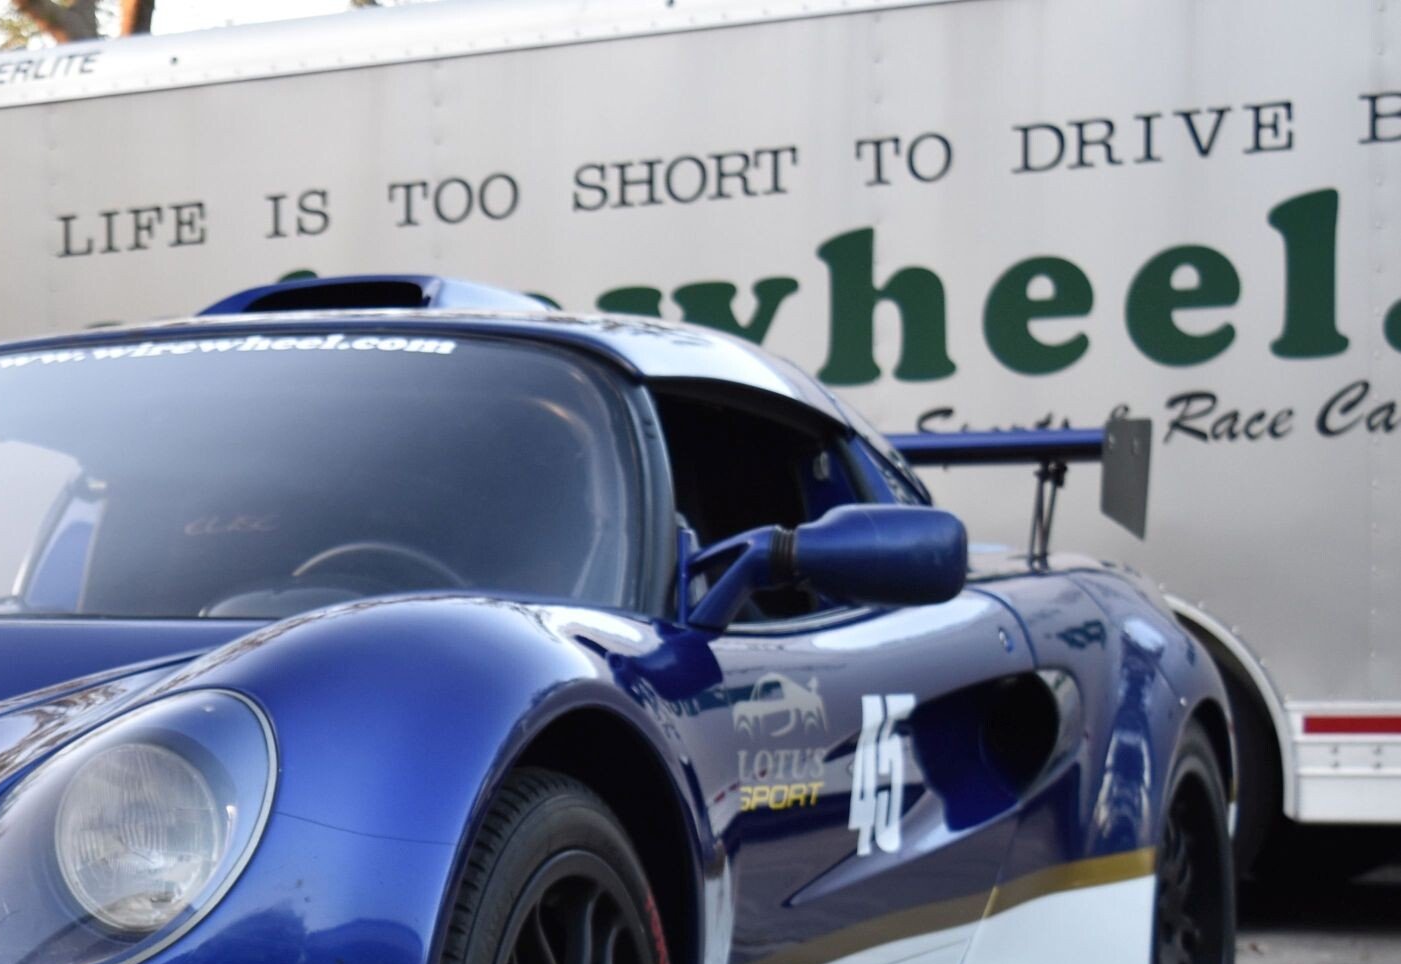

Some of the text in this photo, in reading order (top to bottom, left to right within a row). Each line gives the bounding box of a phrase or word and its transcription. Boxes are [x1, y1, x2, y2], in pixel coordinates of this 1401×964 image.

[56, 201, 207, 258] LIFE
[264, 188, 331, 239] IS
[388, 173, 520, 227] TOO
[572, 146, 798, 212] SHORT
[855, 132, 953, 187] TO
[1011, 100, 1294, 174] DRIVE
[1163, 390, 1295, 445] Race
[737, 747, 826, 780] LOTUS
[848, 694, 917, 855] 45
[739, 781, 825, 811] SPORT
